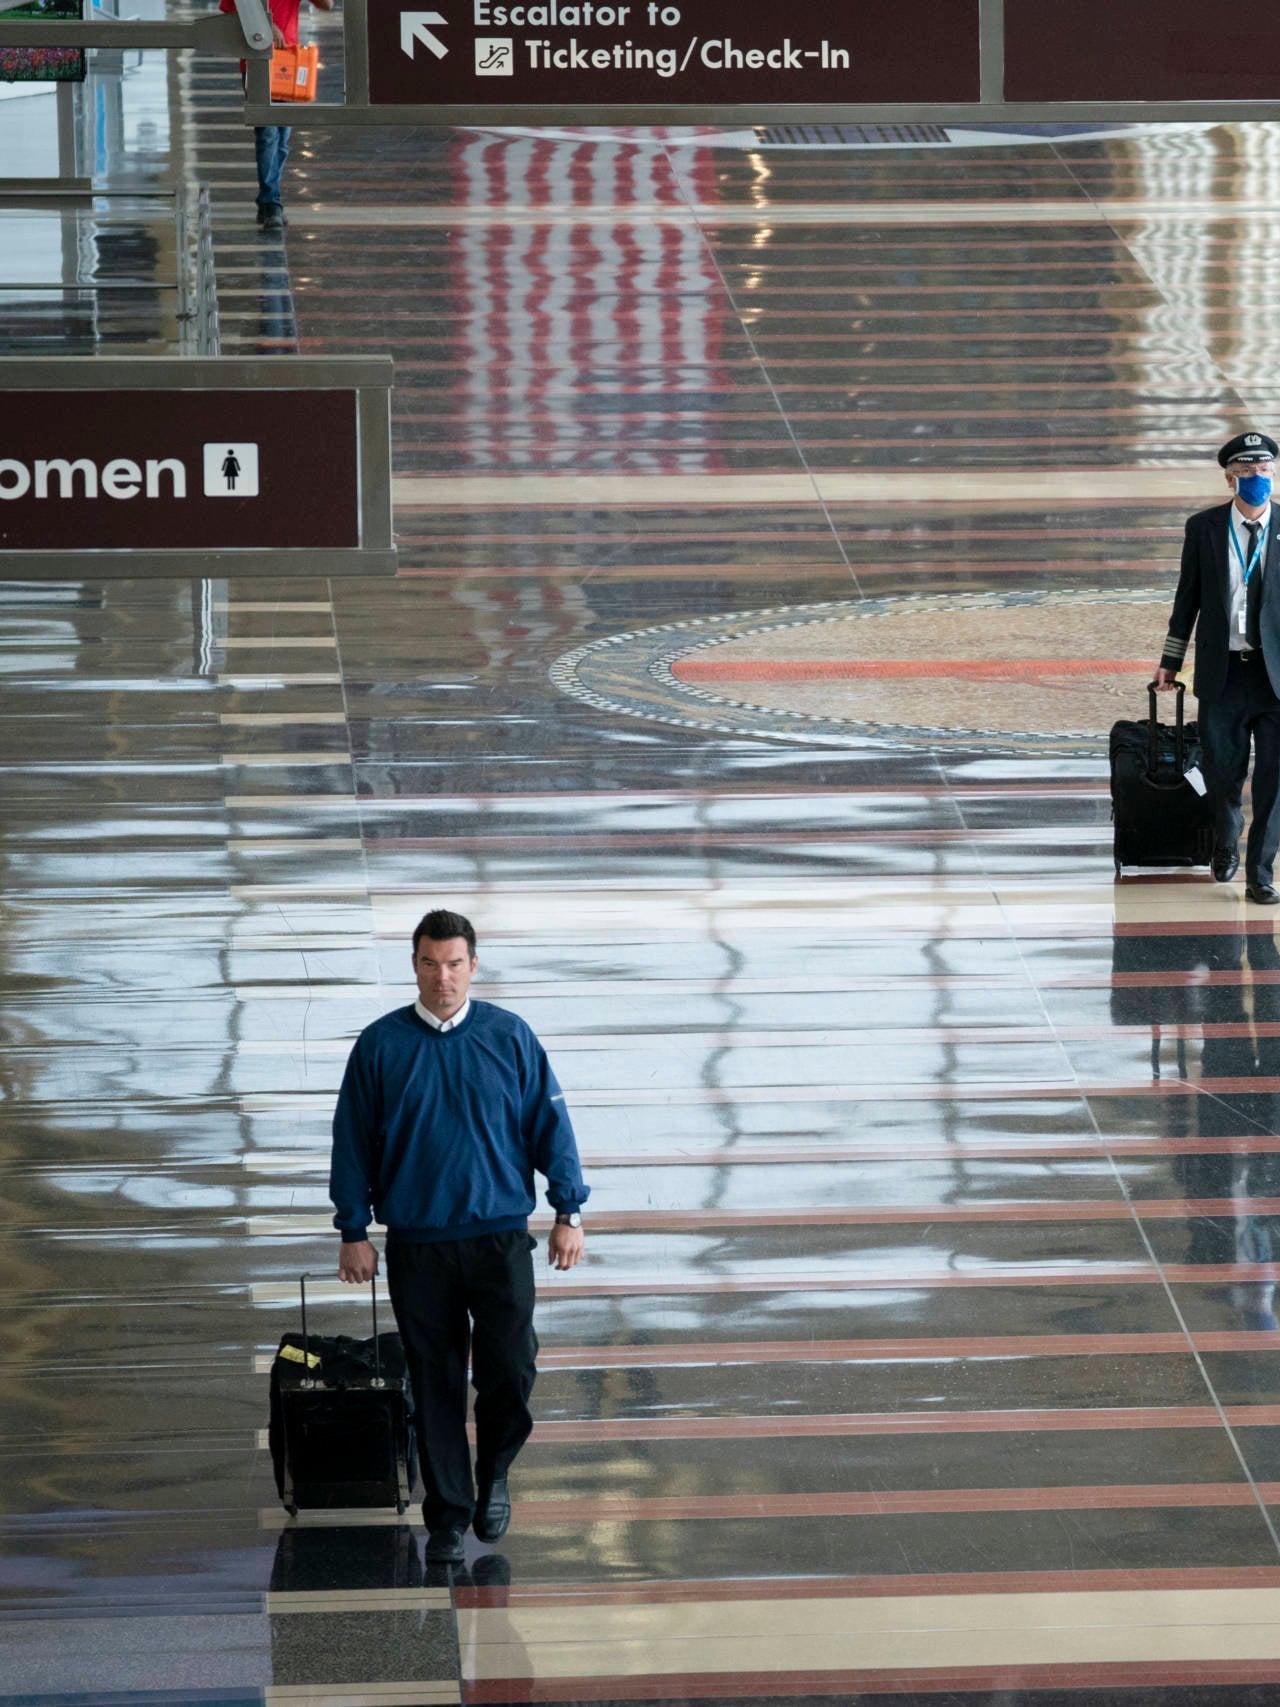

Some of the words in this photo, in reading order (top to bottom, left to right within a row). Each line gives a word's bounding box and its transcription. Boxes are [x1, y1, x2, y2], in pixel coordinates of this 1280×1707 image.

[474, 0, 630, 26] Escalator
[648, 2, 681, 26] to
[525, 36, 850, 77] Ticketing/Check-In
